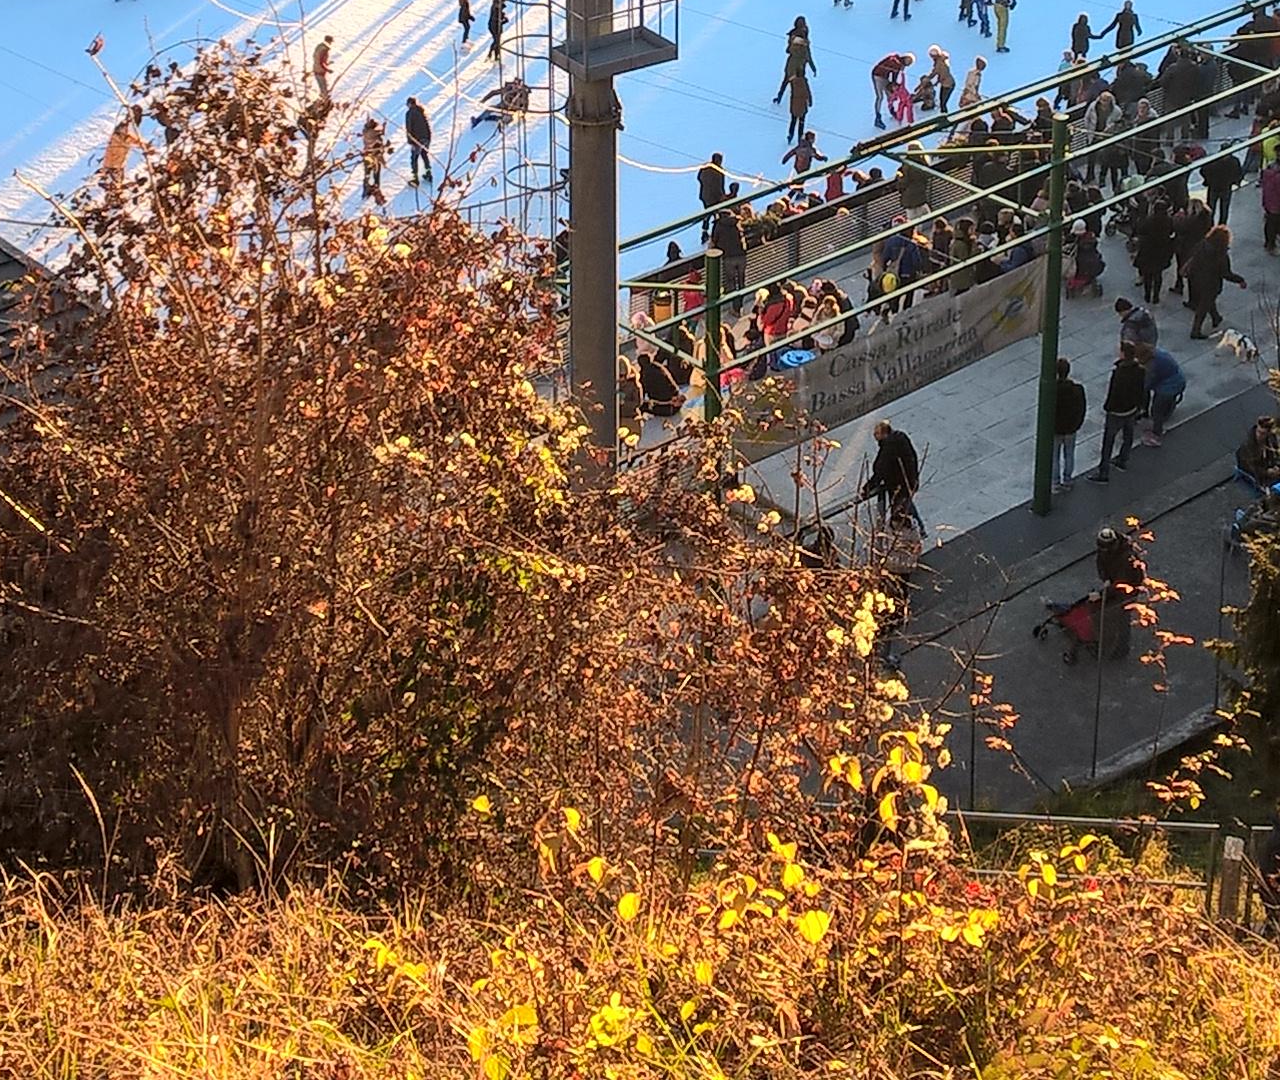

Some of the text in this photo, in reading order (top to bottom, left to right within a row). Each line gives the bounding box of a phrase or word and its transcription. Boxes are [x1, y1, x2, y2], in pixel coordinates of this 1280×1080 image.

[810, 380, 866, 413] Bassa
[873, 327, 978, 385] Vallagarina
[829, 307, 963, 379] Cassa Rurale
